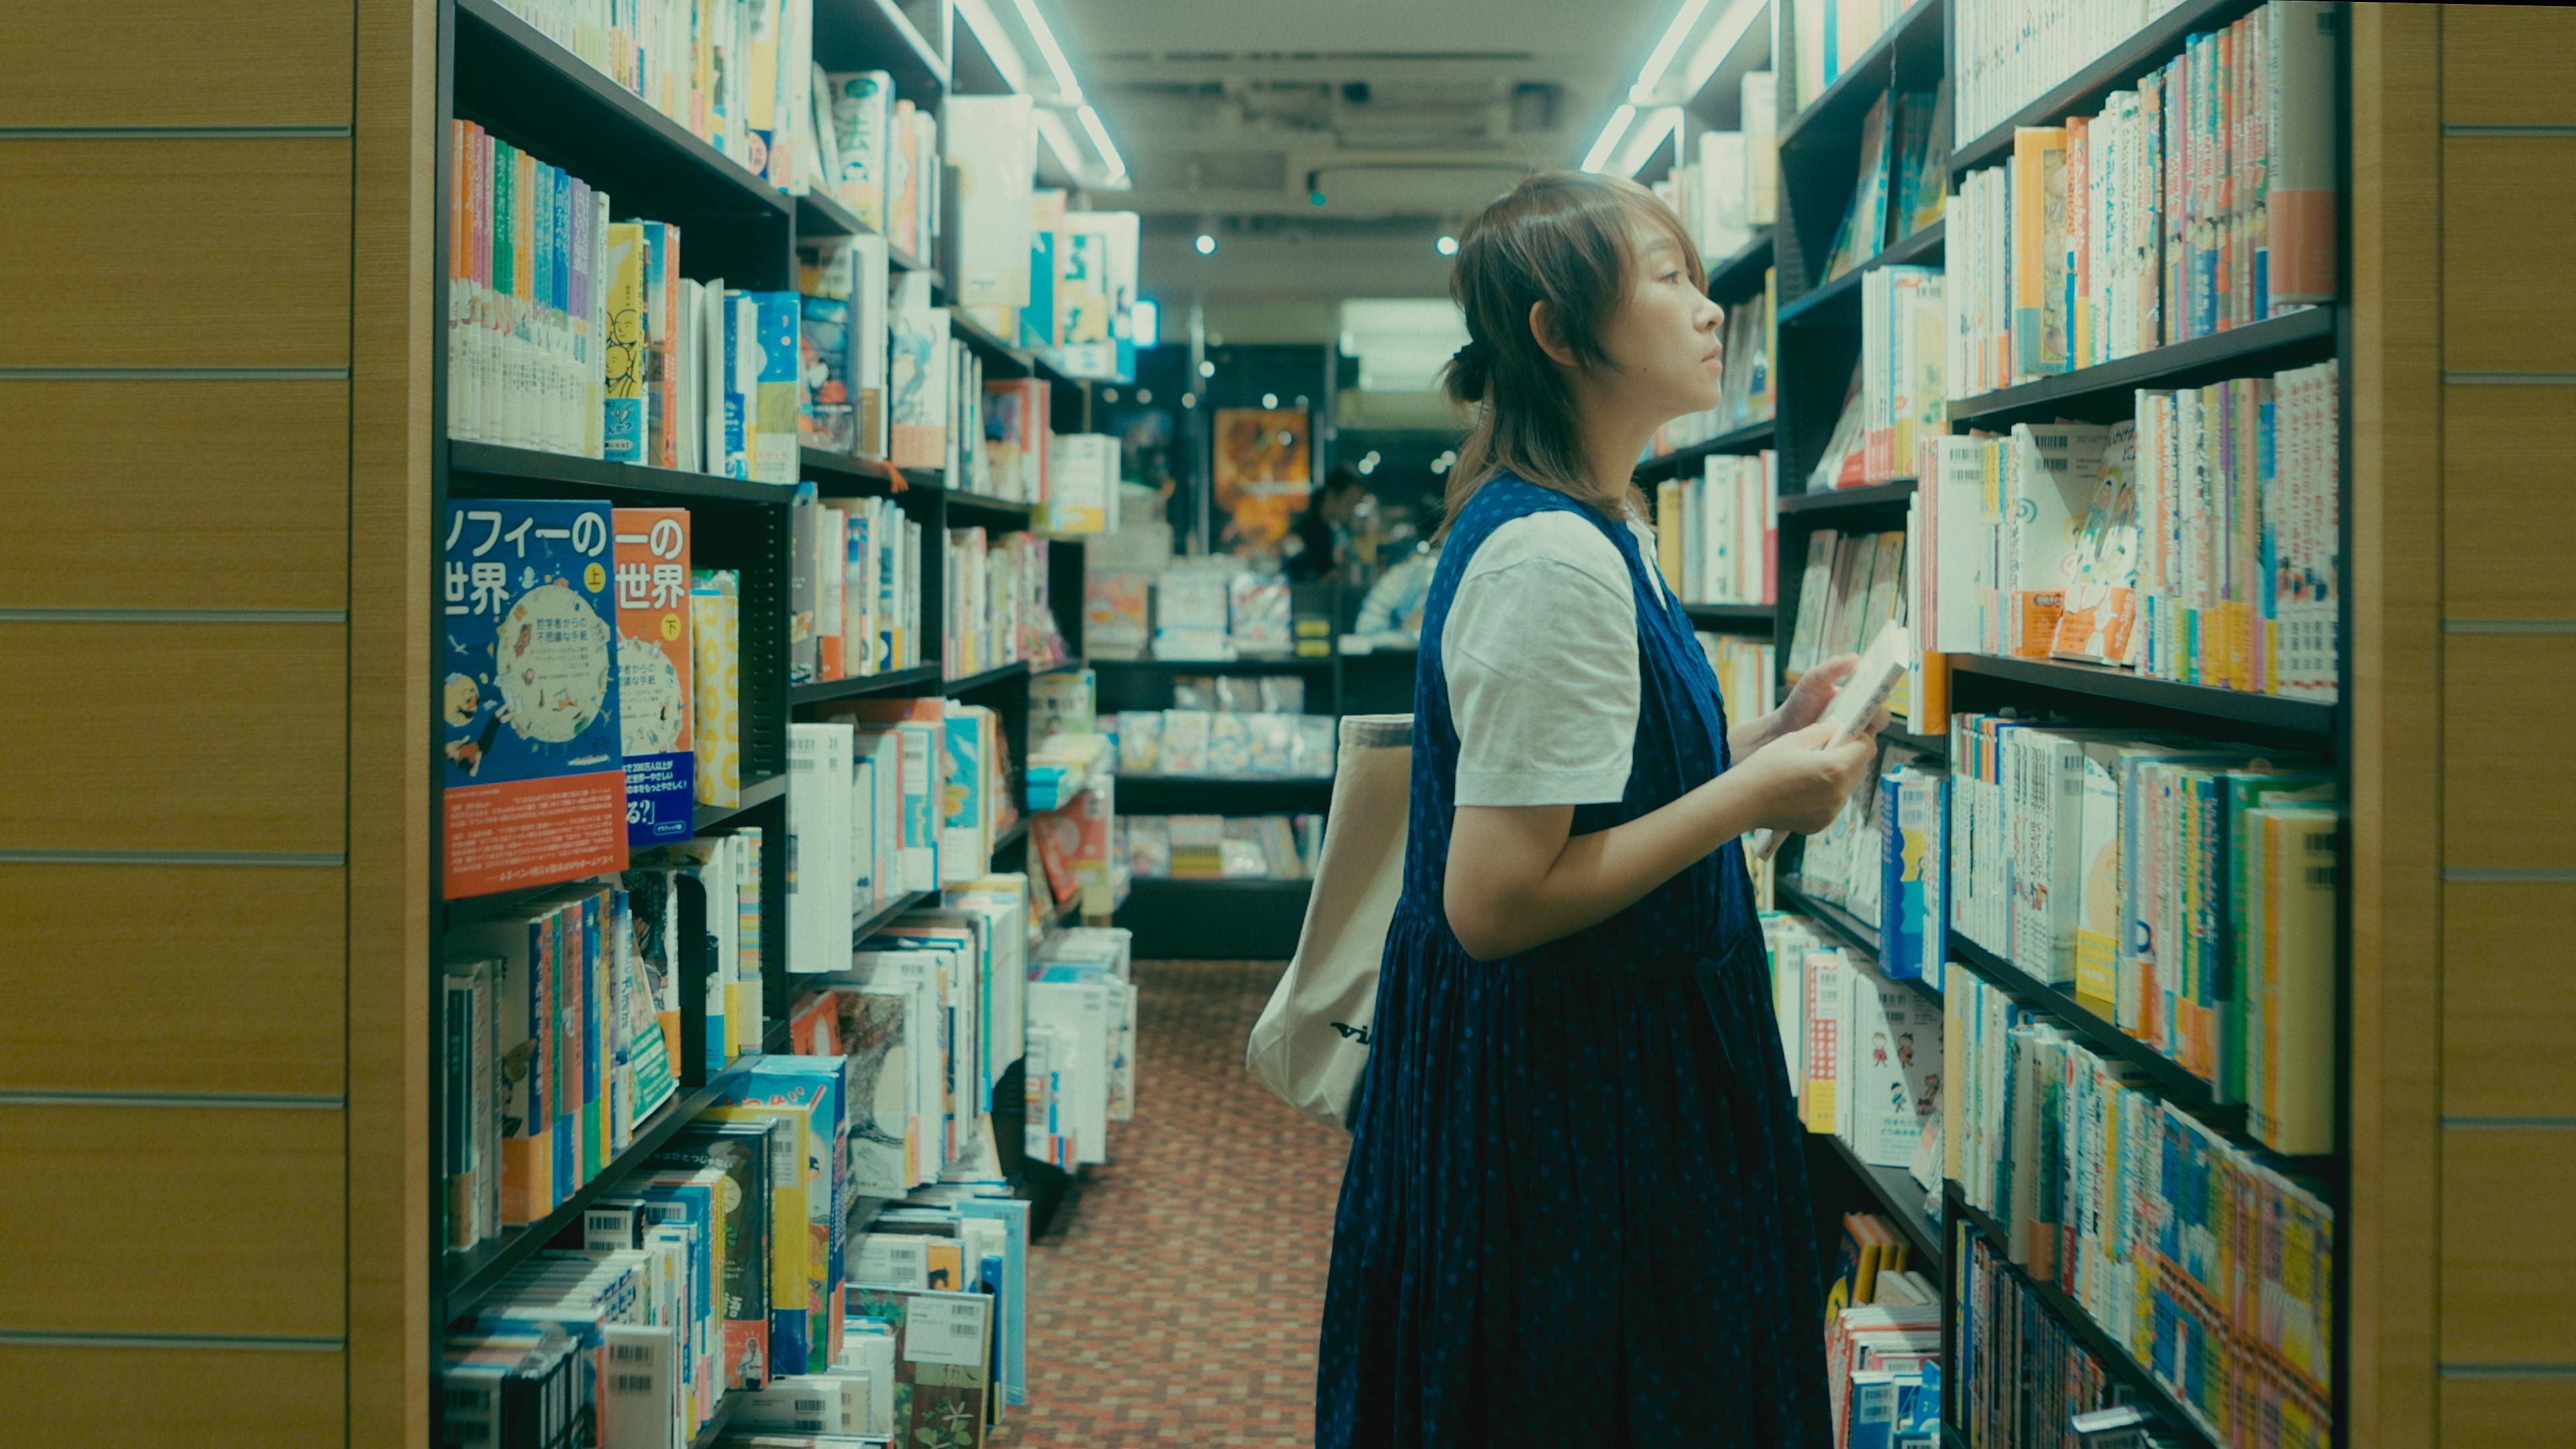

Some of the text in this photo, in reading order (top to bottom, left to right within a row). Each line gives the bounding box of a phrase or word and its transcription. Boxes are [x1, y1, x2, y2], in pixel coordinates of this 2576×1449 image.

[445, 561, 511, 615] 世界
[588, 568, 601, 585] 上
[614, 563, 686, 610] 世界
[665, 620, 677, 635] 下
[1330, 1022, 1371, 1045] vi
